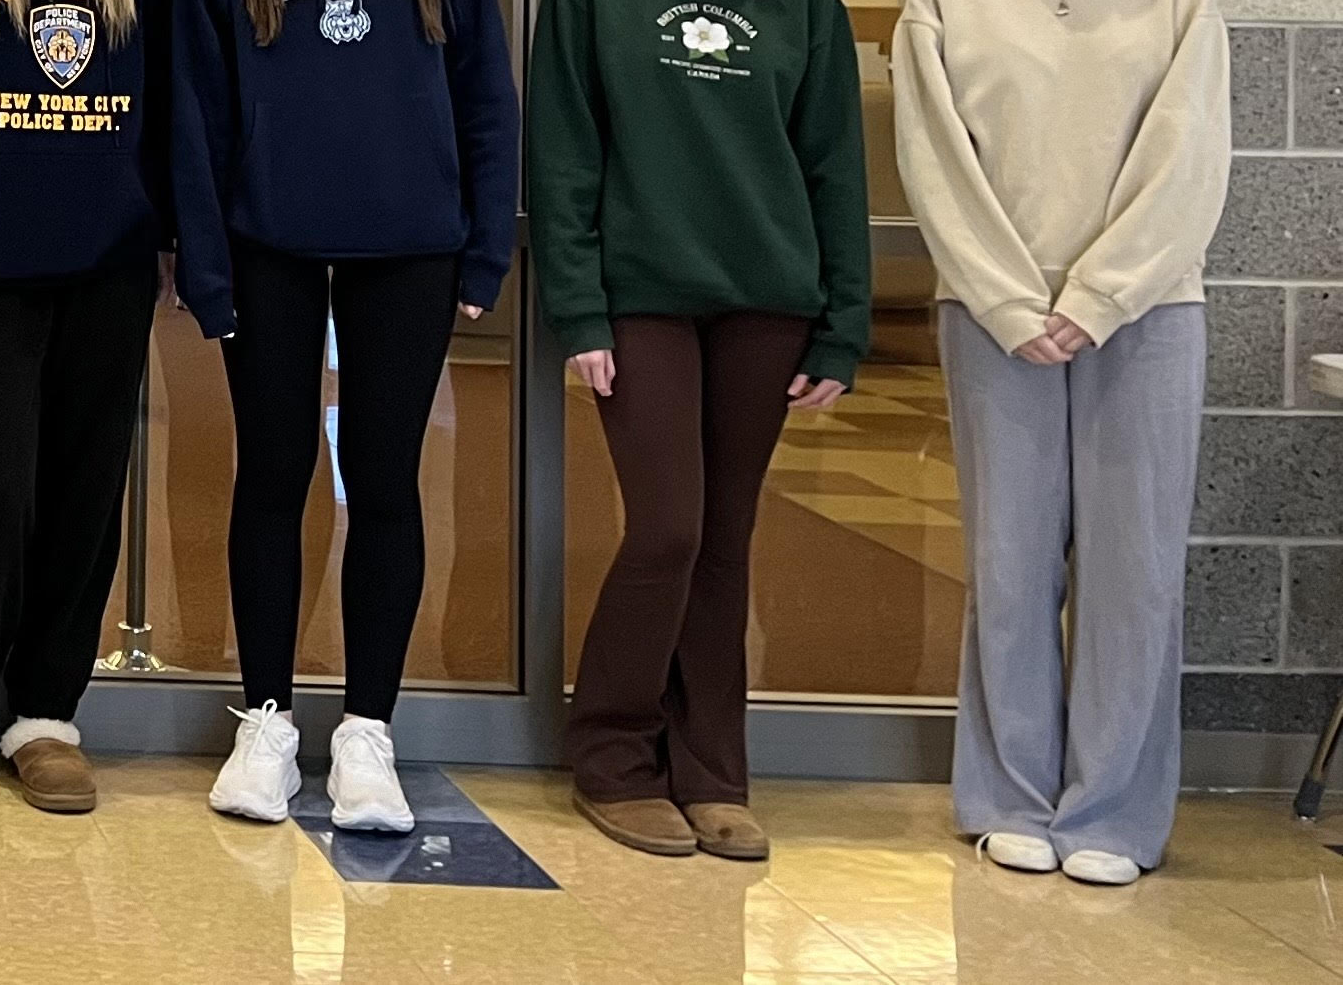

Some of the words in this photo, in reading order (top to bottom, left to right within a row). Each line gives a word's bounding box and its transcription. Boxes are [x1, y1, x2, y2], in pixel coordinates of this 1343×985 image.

[45, 8, 79, 20] POLICE
[702, 4, 758, 39] COLUMBIA
[33, 17, 91, 34] DEPARTMENT
[38, 94, 89, 112] YORK
[94, 95, 131, 113] CITY
